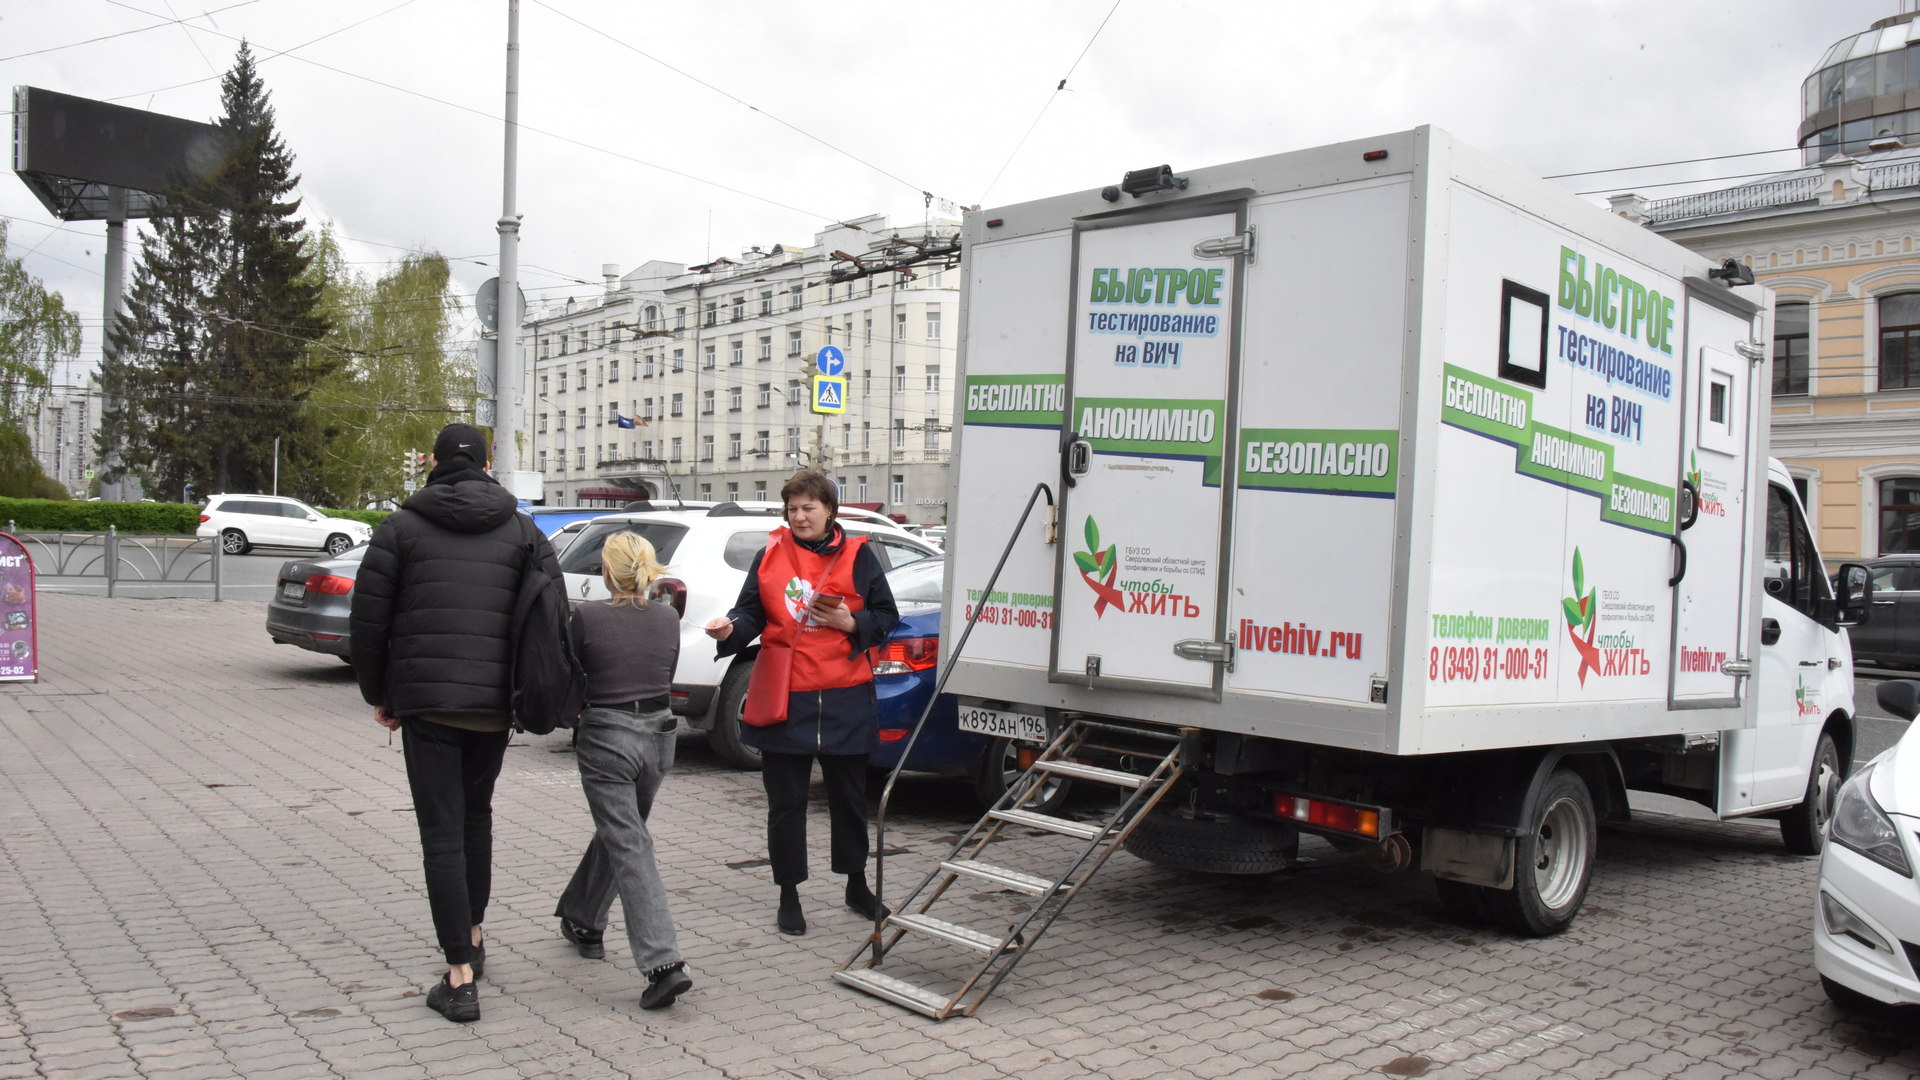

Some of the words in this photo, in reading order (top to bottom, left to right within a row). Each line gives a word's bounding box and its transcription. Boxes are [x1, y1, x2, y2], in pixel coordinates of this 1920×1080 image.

[1090, 268, 1223, 304] БЫСТРОЕ
[1557, 245, 1675, 354] БЫСТРОЕ
[1089, 312, 1216, 335] тестирование
[1115, 344, 1136, 363] на
[1143, 342, 1179, 365] ВИЧ
[1557, 324, 1671, 399] тестирование
[967, 384, 1065, 411] БЕСПЛАТНО
[1446, 375, 1527, 430] БЕСПЛАТНО
[1078, 407, 1215, 443] АНОНИМНО
[1586, 394, 1605, 429] на
[1611, 395, 1642, 441] ВИЧ
[1246, 441, 1389, 477] БЕЗОПАСНО
[1531, 432, 1605, 481] АНОНИМНО
[1611, 484, 1670, 523] БЕЗОПАСНО
[1704, 500, 1726, 517] ЖИТЬ
[1125, 547, 1140, 555] ГБУЗ
[1141, 547, 1151, 555] СО
[1125, 555, 1161, 565] Свердловский
[1162, 557, 1189, 565] областной
[1124, 564, 1158, 572] профилактики
[1163, 566, 1182, 574] борьбы
[1190, 567, 1206, 576] СПИД
[966, 588, 1008, 605] телфон
[1010, 592, 1054, 608] доверия
[1120, 578, 1174, 594] чтобы
[965, 604, 972, 621] 8
[974, 605, 999, 625] 343)
[1001, 607, 1054, 629] 31-000-31
[1127, 591, 1200, 618] ЖИТЬ
[1239, 618, 1362, 660] livehiv.ru
[1432, 610, 1493, 643] телефон
[1496, 617, 1549, 644] доверия
[1597, 630, 1635, 649] чтобы
[1429, 646, 1439, 680] 8
[1443, 646, 1479, 683] (343)
[1483, 647, 1548, 679] 31-000-31
[1602, 649, 1651, 676] ЖИТЬ
[1681, 645, 1726, 672] livehiv.ru
[962, 709, 1017, 735] К893АН
[1019, 716, 1042, 733] 196
[1024, 731, 1037, 739] RUS
